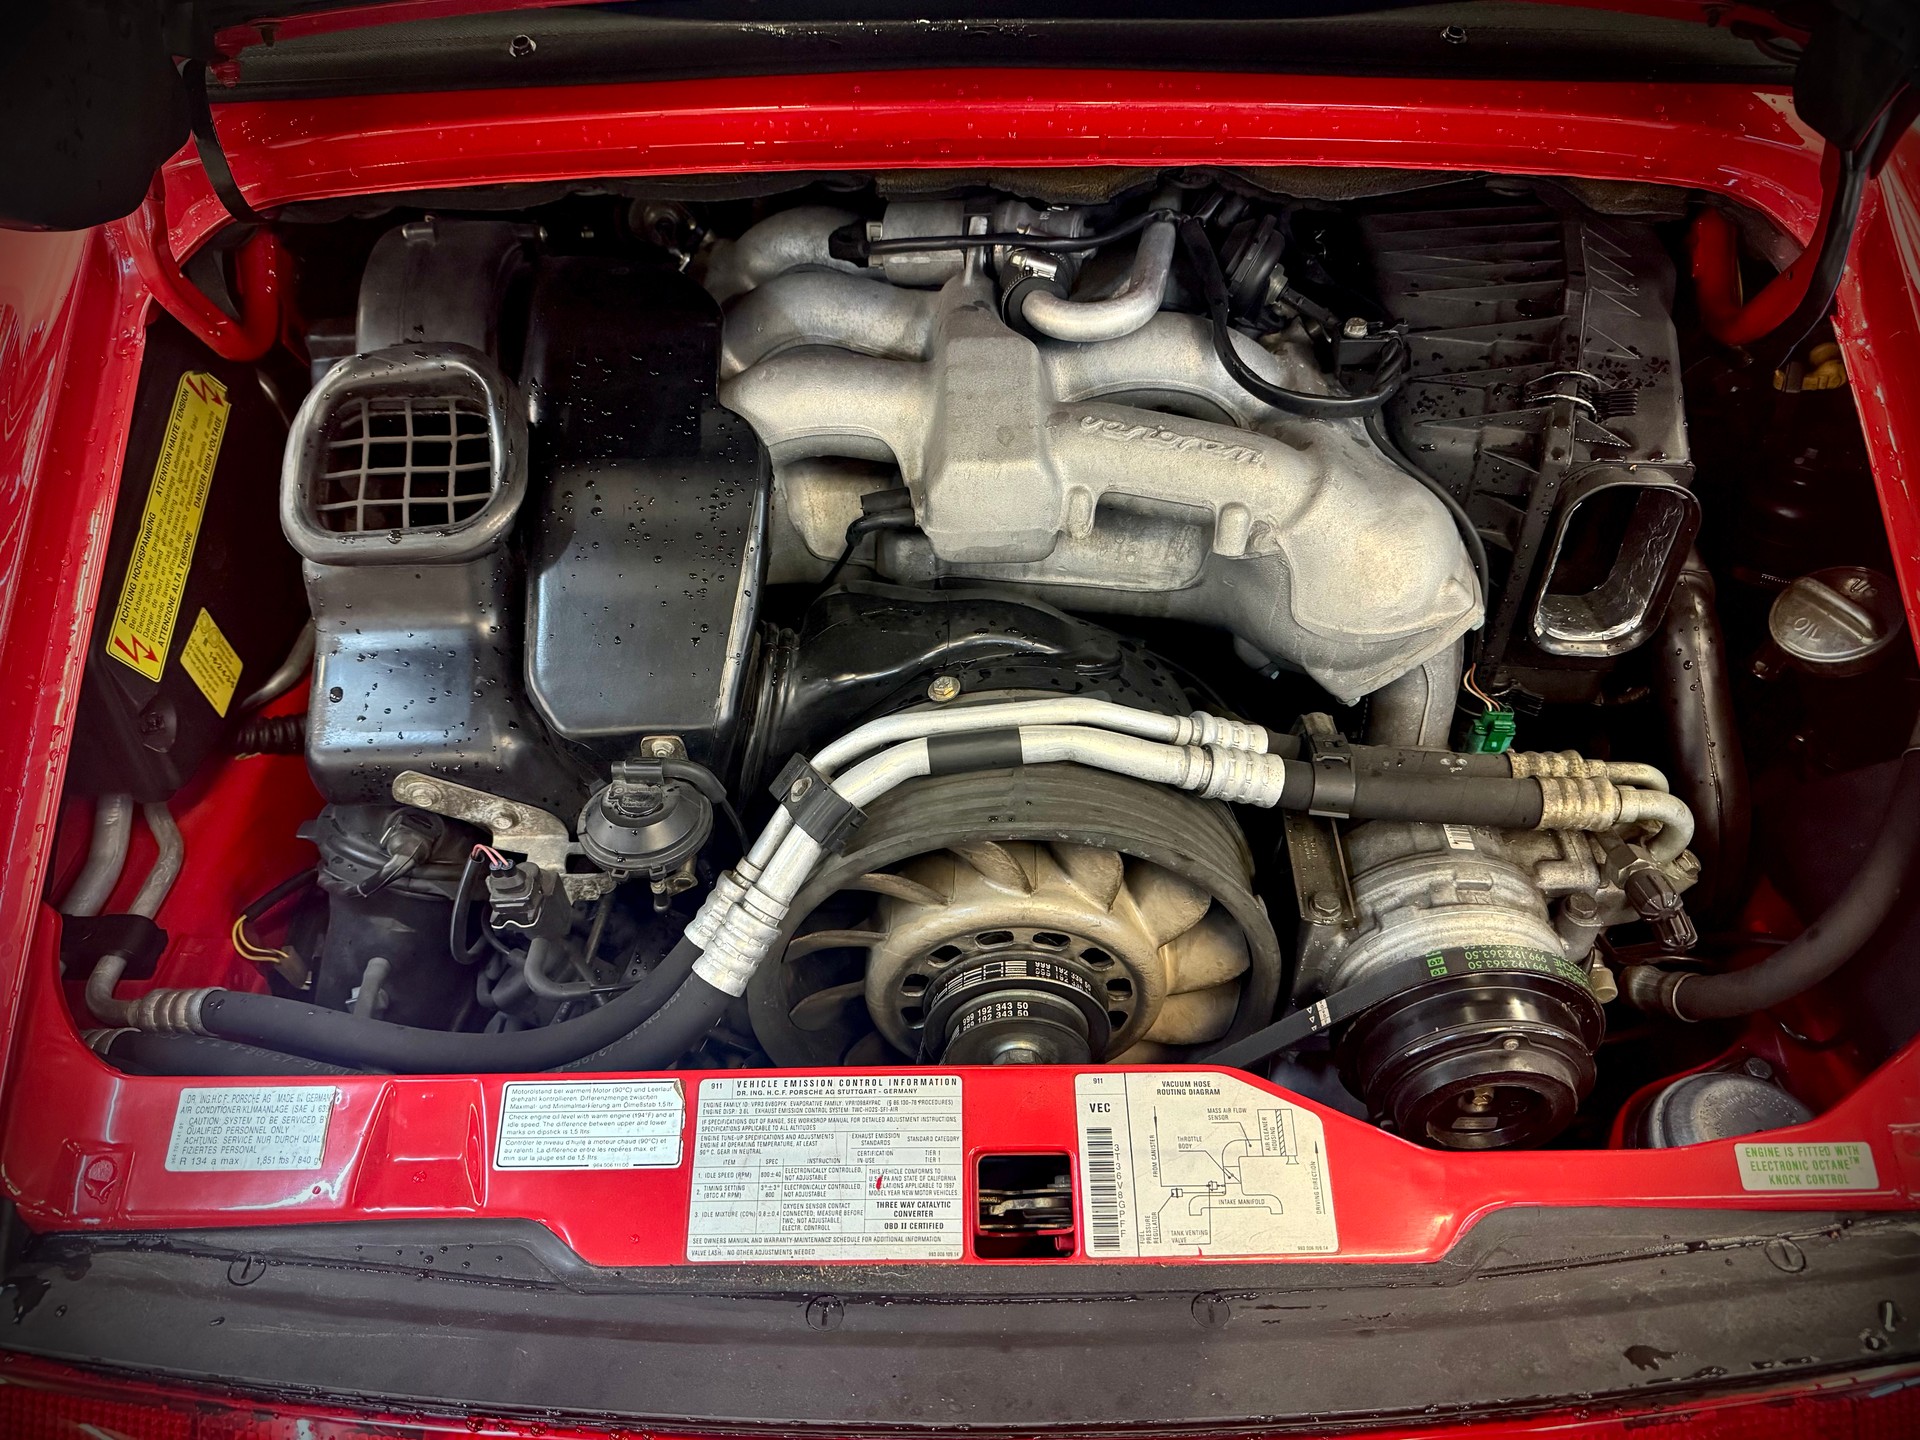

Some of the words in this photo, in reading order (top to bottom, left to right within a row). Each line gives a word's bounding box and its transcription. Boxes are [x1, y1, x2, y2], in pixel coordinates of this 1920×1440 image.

[157, 450, 172, 497] ATTENTION
[168, 422, 180, 451] HAUTE
[176, 387, 189, 422] TENSION
[193, 473, 207, 509] DANGER
[202, 453, 212, 474] HIGH
[208, 415, 222, 453] VOLTAGE
[121, 581, 136, 624] ACHTUNG
[133, 511, 156, 582] HOCHSPANNUNG
[135, 605, 148, 634] Electric
[144, 581, 154, 603] shock
[150, 548, 163, 579] suffered
[157, 594, 176, 647] ATTENZIONE
[171, 570, 182, 594] ALTA
[177, 530, 193, 571] TENSIONE
[132, 582, 146, 613] Arbeiten
[142, 610, 155, 639] Danger
[154, 577, 163, 595] mort
[1794, 618, 1820, 641] OIL
[1429, 958, 1442, 966] 49
[1465, 950, 1546, 963] 999.192.363.50
[1432, 967, 1445, 976] 49
[1468, 960, 1551, 973] 999.192.363.50
[963, 1013, 974, 1025] 999
[978, 1005, 992, 1015] 192
[996, 1002, 1012, 1011] 343
[978, 1014, 992, 1023] 192
[996, 1011, 1012, 1019] 343
[737, 1080, 778, 1088] VEHICLE
[839, 1079, 882, 1087] CONTROL
[888, 1078, 957, 1086] INFORMATION
[277, 1094, 294, 1102] MADE
[180, 1106, 192, 1114] AIR
[1090, 1103, 1111, 1112] VEC
[269, 1116, 278, 1124] BE
[282, 1116, 316, 1124] SERVICED
[187, 1126, 222, 1134] QUALIFIED
[226, 1126, 266, 1134] PERSONNEL
[271, 1126, 289, 1134] ONLY
[223, 1136, 253, 1144] SERVICE
[275, 1135, 299, 1143] DURCH
[1270, 1127, 1278, 1150] HOUSING
[182, 1146, 217, 1154] FIZIERTES
[221, 1146, 257, 1154] PERSONAL
[1149, 1135, 1157, 1160] CANISTER
[1745, 1147, 1780, 1157] ENGINE
[1784, 1147, 1793, 1156] IS
[1796, 1146, 1830, 1156] FITTED
[1834, 1145, 1859, 1155] WITH
[180, 1157, 186, 1165] R
[192, 1157, 206, 1165] 134
[257, 1156, 275, 1165] 1,851
[298, 1156, 311, 1164] 840
[1751, 1161, 1808, 1171] ELECTRONIC
[1310, 1161, 1319, 1190] DIRECTION
[1768, 1175, 1801, 1184] KNOCK
[1806, 1174, 1850, 1184] CONTROL
[1314, 1192, 1322, 1214] DRIVING
